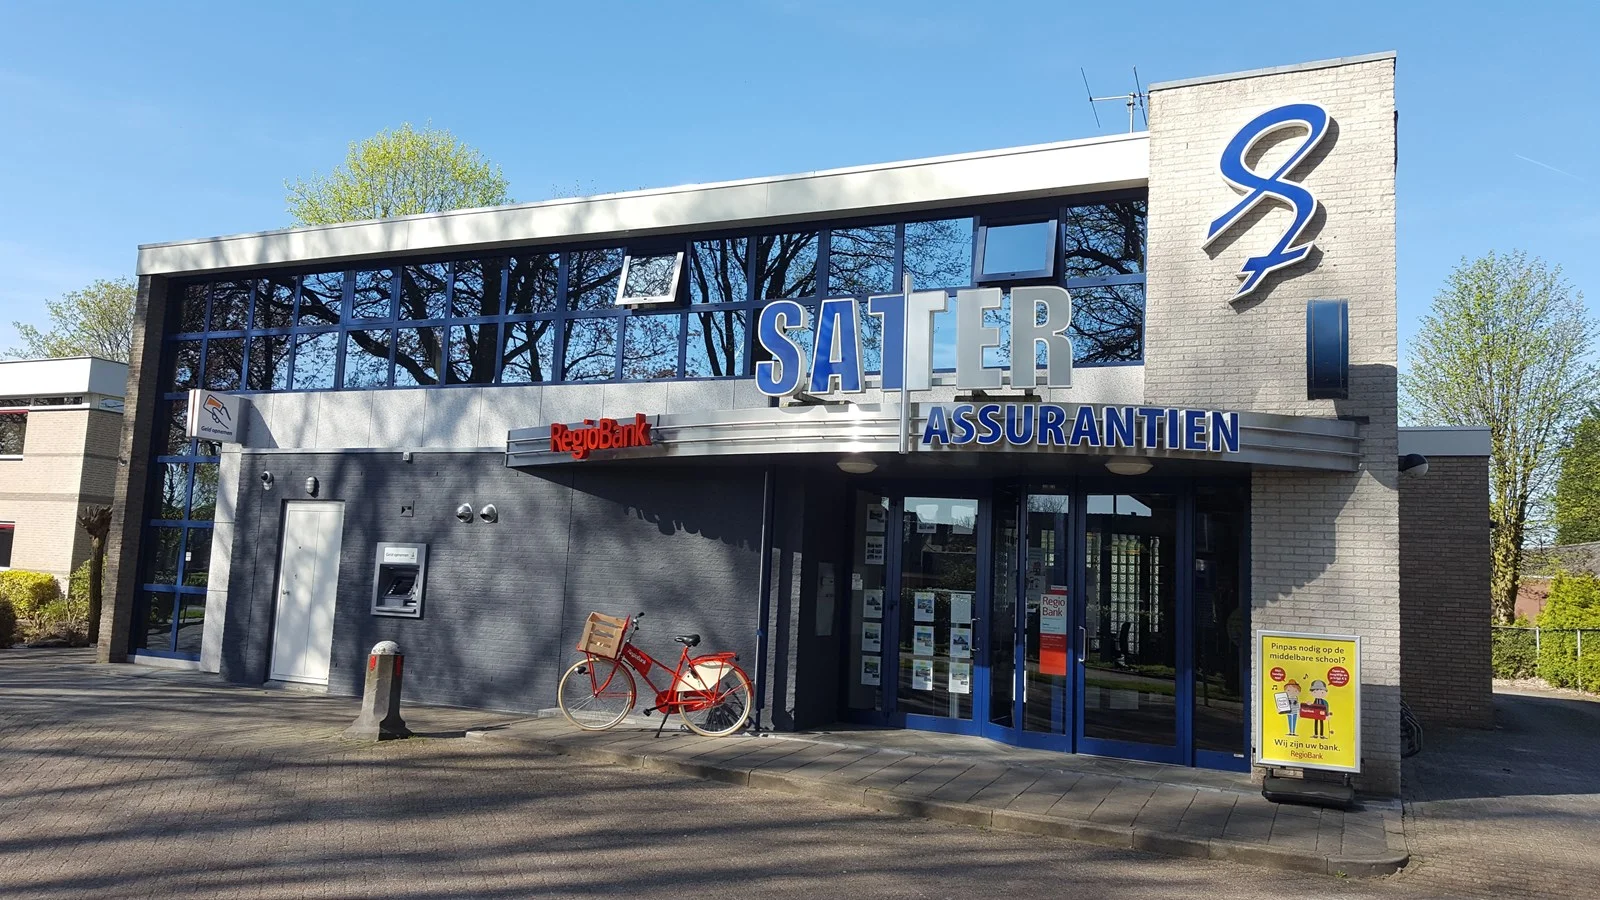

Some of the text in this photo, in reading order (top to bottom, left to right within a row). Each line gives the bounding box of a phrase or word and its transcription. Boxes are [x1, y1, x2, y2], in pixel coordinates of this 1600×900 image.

[755, 285, 1073, 396] SATER
[201, 425, 233, 436] Geld opnemen
[921, 404, 1240, 453] ASSURANTIEN
[551, 413, 651, 459] RegioBank
[1042, 596, 1066, 608] Regio
[1042, 607, 1063, 617] Bank
[1271, 642, 1297, 651] Pinpas
[1299, 645, 1321, 654] nodig
[1269, 653, 1346, 664] middelbare school?
[1274, 739, 1288, 748] Wij
[1289, 741, 1304, 749] zijn
[1318, 743, 1341, 752] bank.
[1290, 750, 1324, 760] RegioBank
